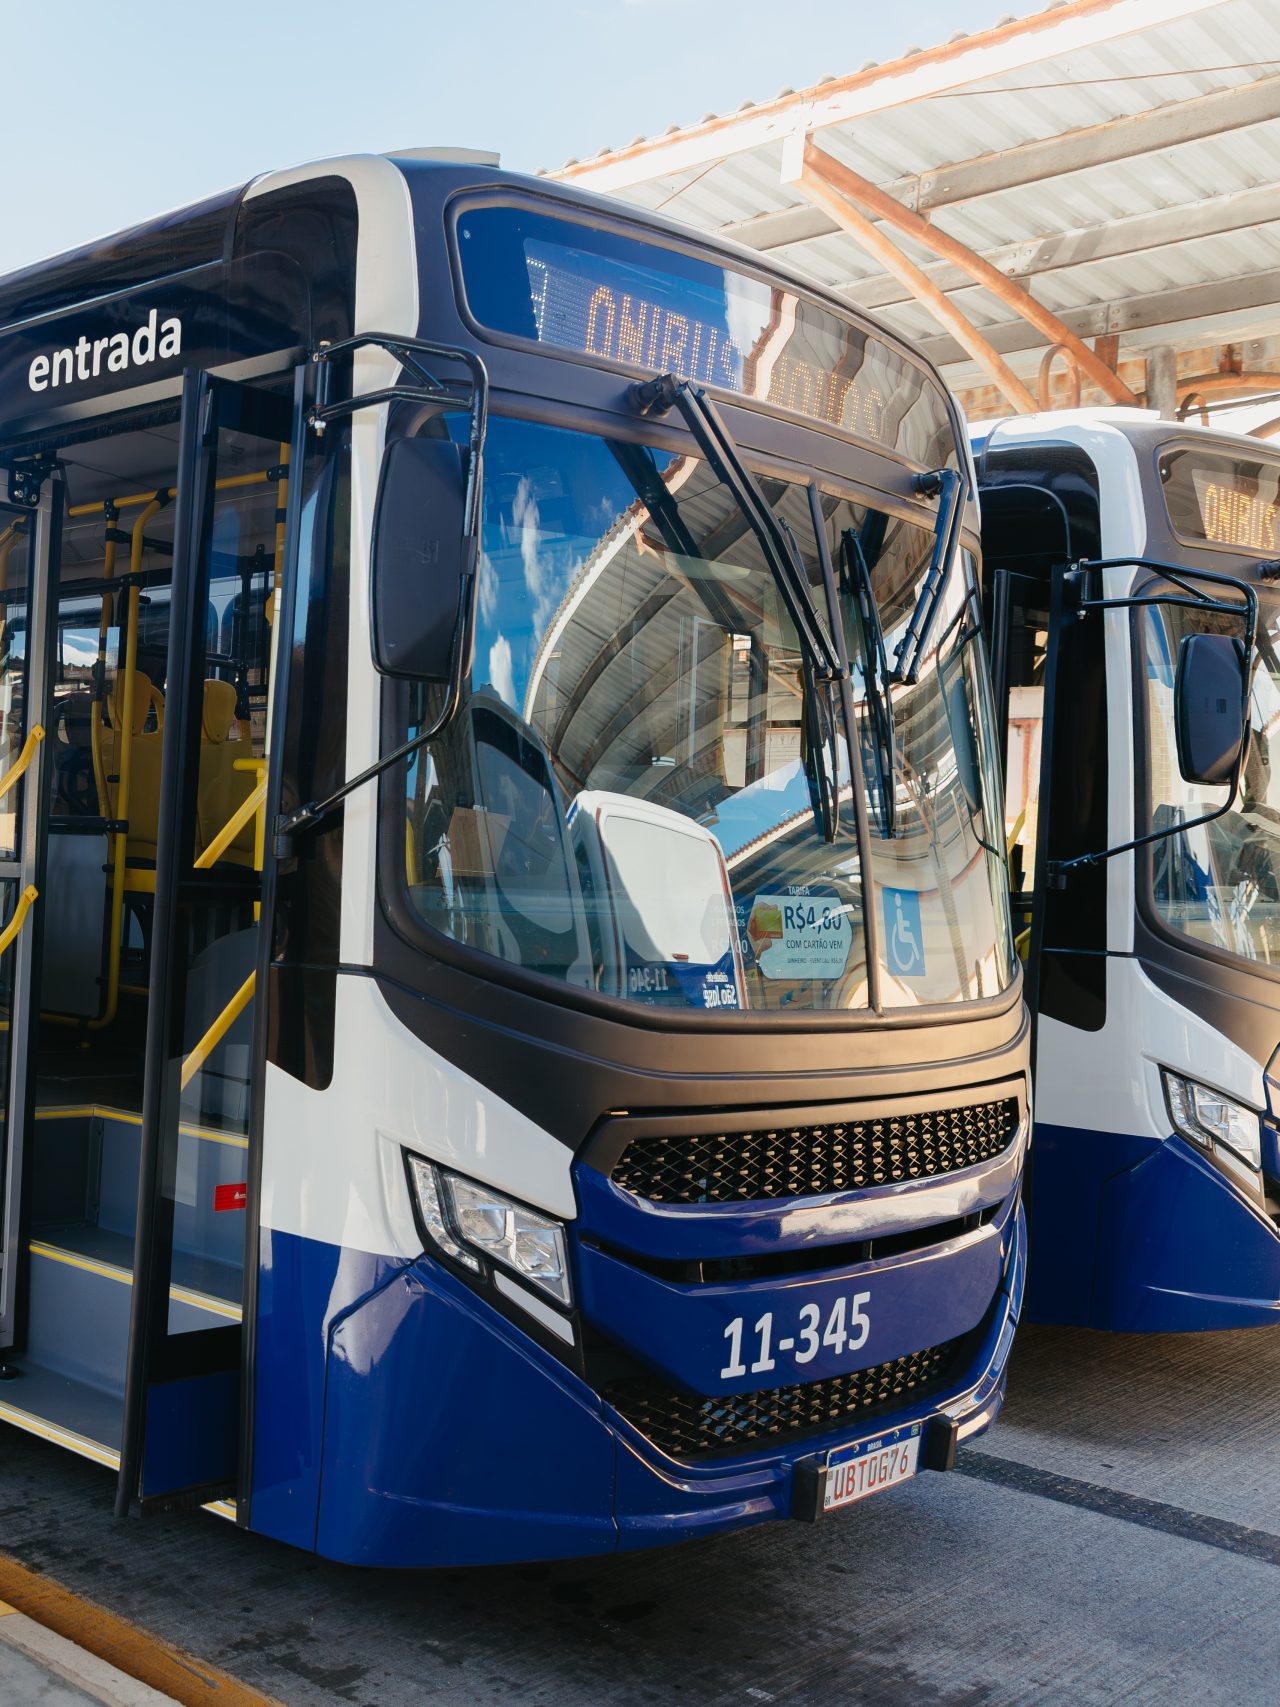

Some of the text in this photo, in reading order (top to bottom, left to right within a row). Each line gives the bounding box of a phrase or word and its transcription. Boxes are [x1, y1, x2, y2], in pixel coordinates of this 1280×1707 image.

[28, 308, 182, 392] entrada
[787, 885, 810, 896] TARIFA
[786, 938, 843, 950] COM CARTÃO VEM
[720, 1291, 871, 1379] 11-345
